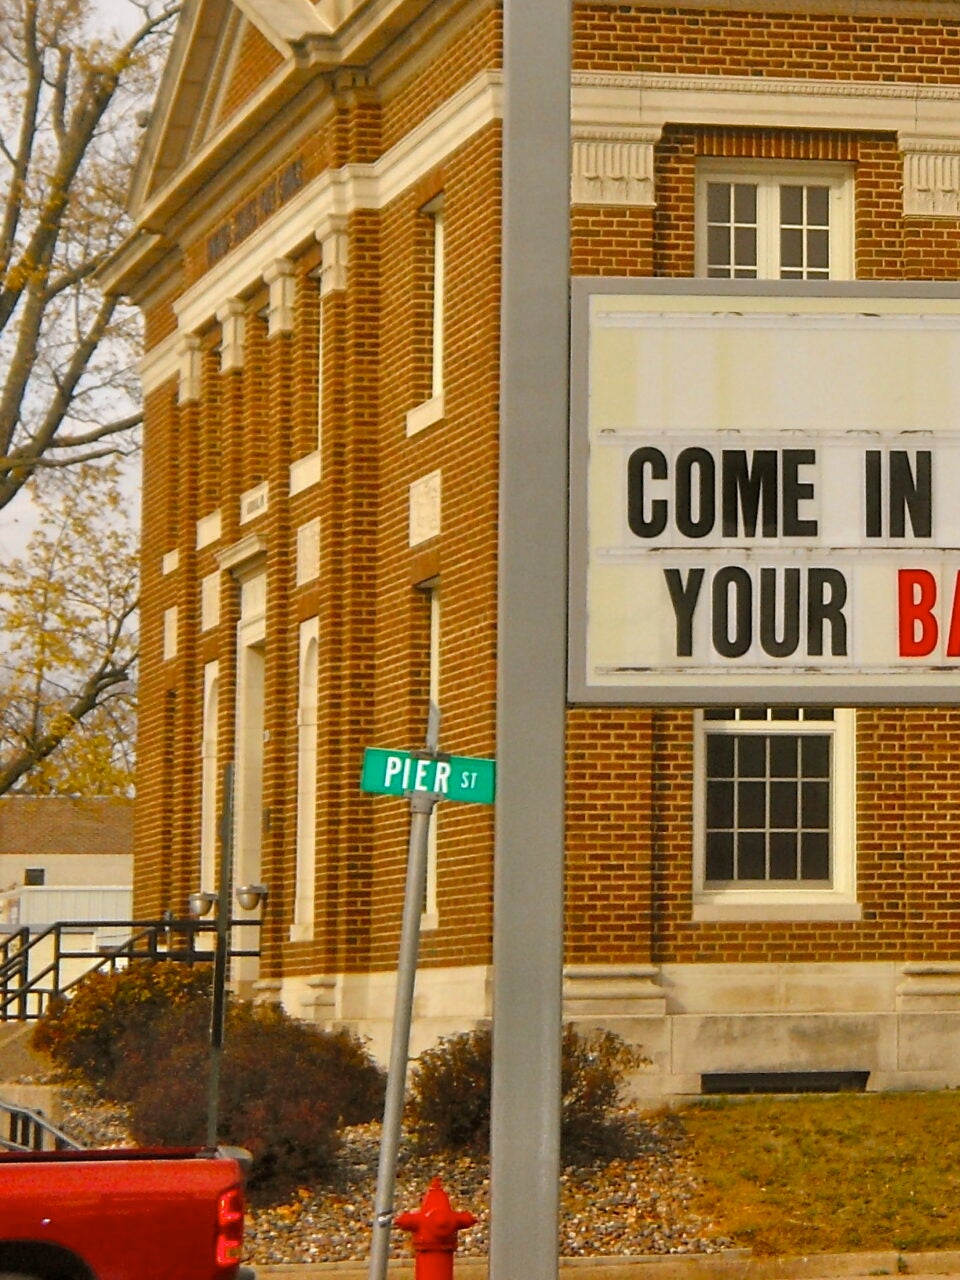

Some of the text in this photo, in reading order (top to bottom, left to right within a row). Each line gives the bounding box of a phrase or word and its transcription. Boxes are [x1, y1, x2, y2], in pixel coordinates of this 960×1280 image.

[626, 446, 818, 539] COME
[865, 450, 933, 539] IN
[663, 565, 848, 659] YOUR
[384, 756, 478, 794] PIER ST
